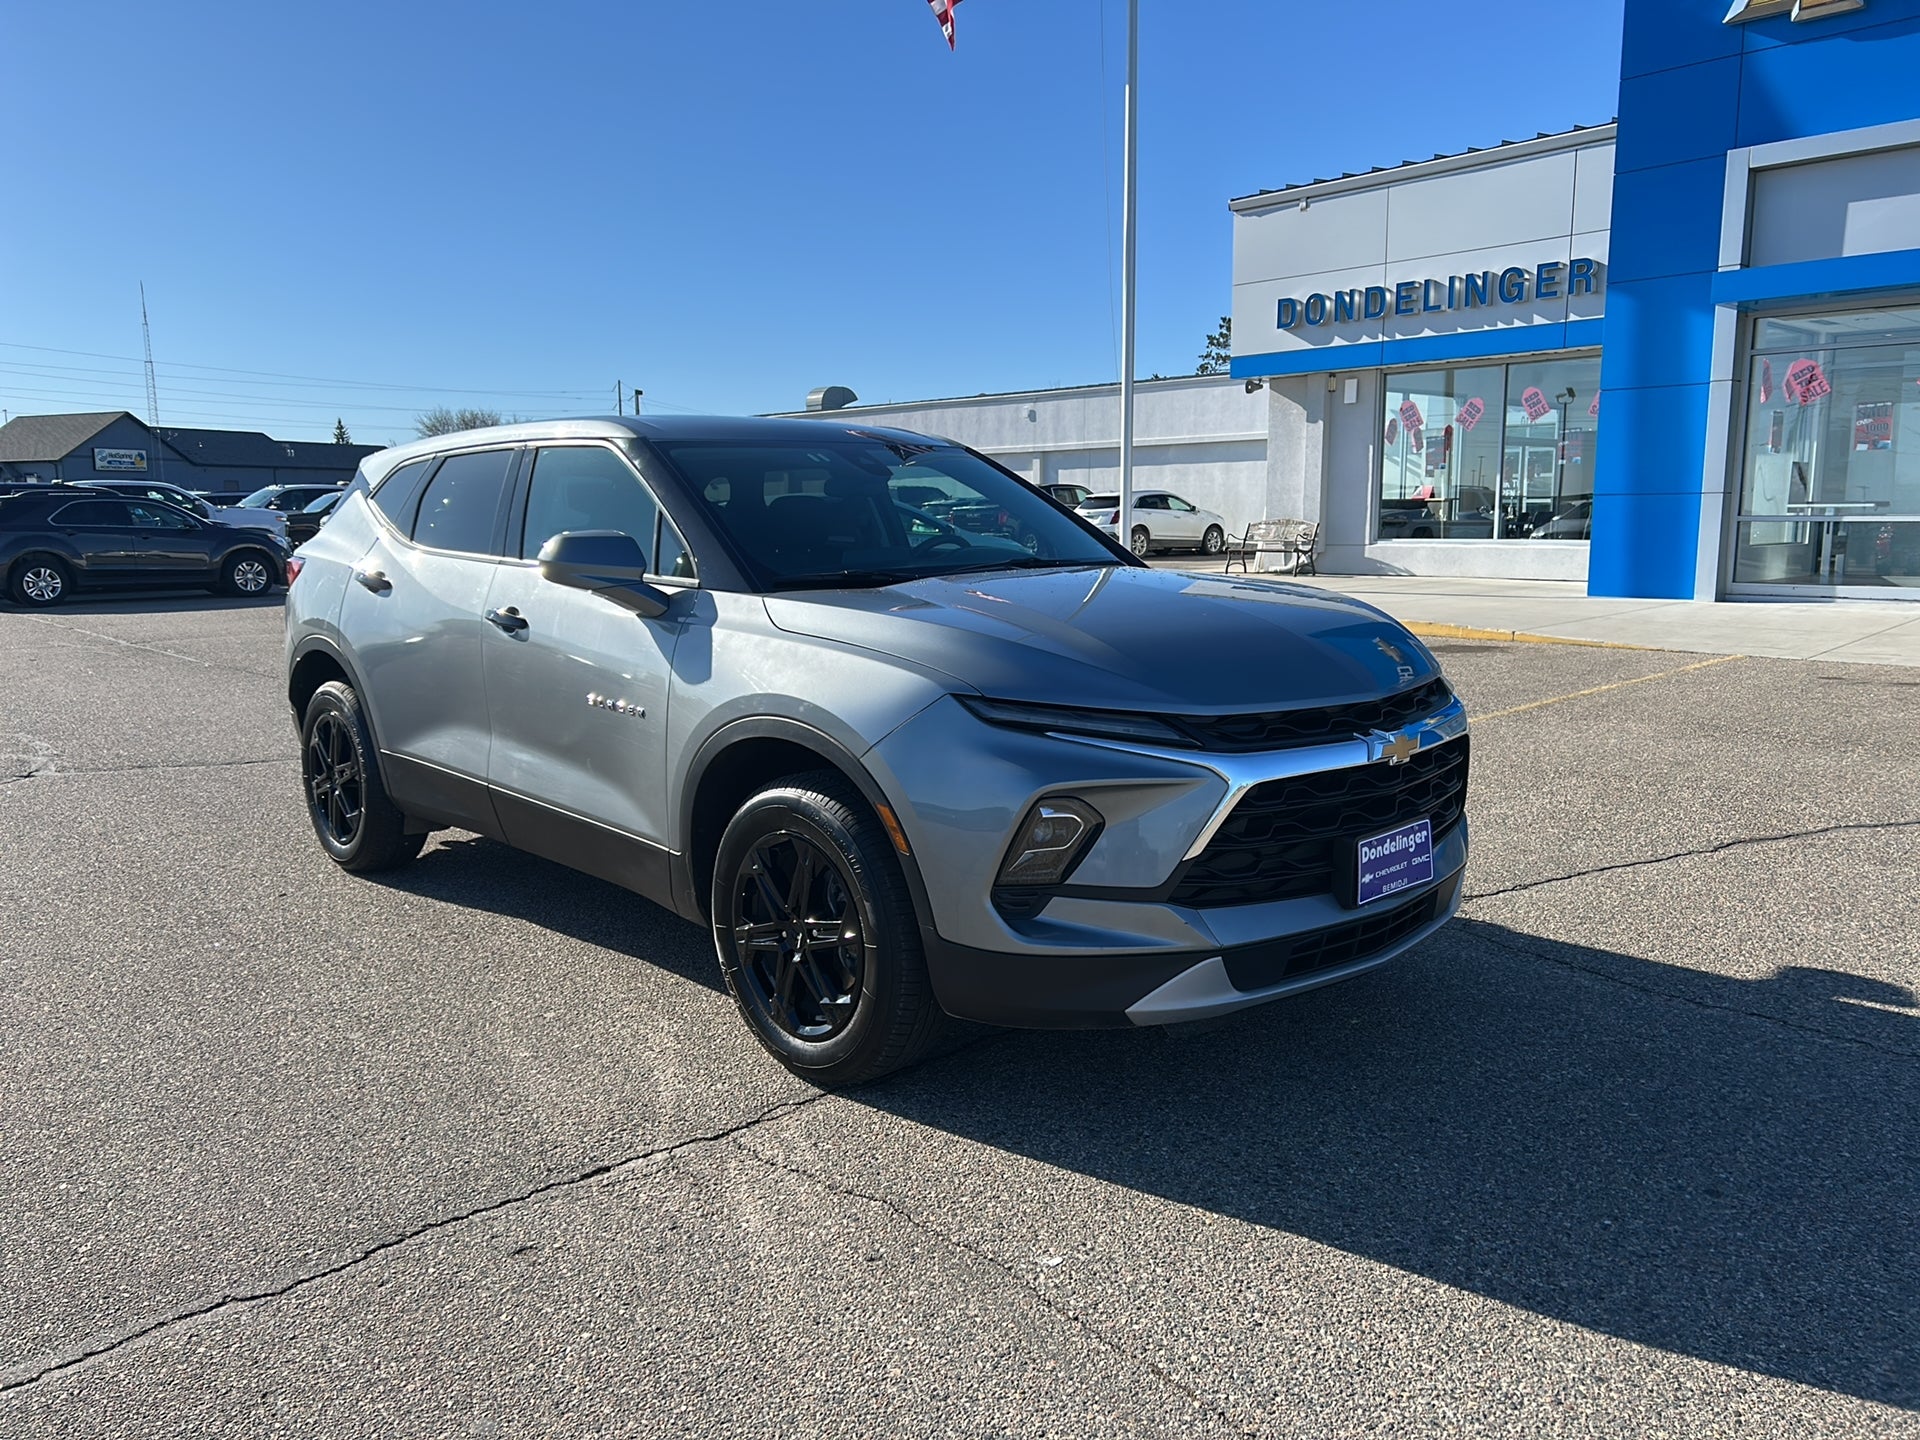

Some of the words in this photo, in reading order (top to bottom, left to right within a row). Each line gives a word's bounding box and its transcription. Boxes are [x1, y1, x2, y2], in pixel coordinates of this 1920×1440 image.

[1276, 257, 1597, 330] DONDELINGER
[1792, 365, 1815, 381] RED
[1800, 381, 1828, 403] SALE
[1459, 413, 1474, 430] SALE
[1528, 405, 1549, 421] SALE
[1361, 830, 1428, 864] Dondelinger
[1375, 861, 1408, 878] CHEVROLET
[1411, 854, 1430, 865] GMC
[1382, 877, 1408, 893] BEMIDJI
